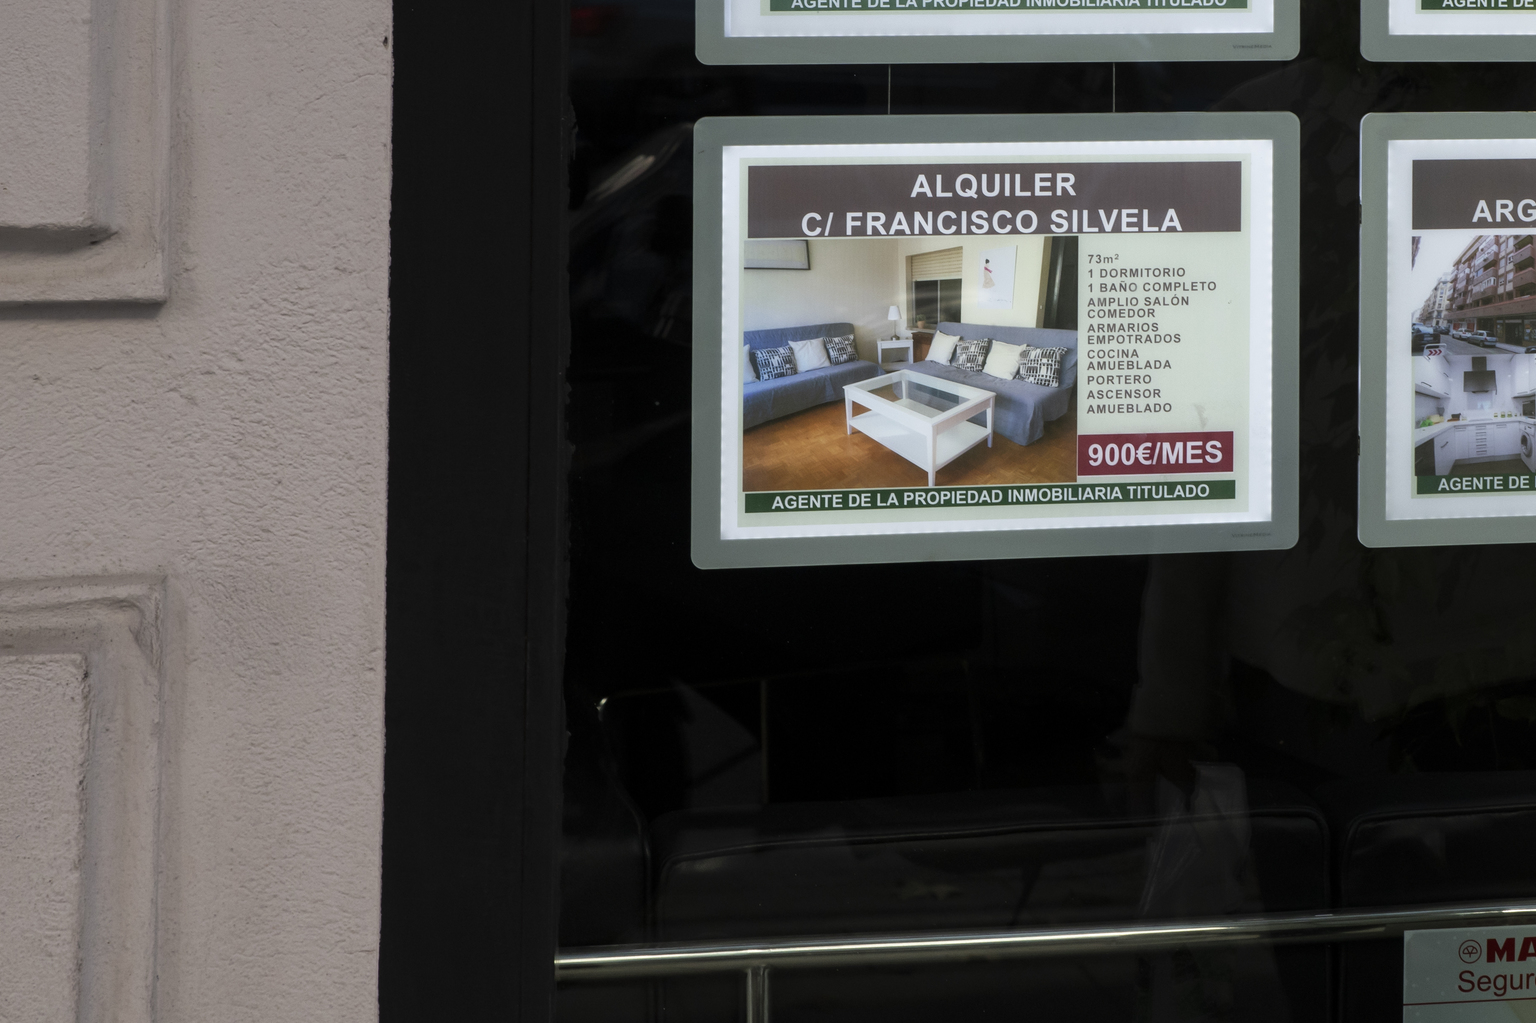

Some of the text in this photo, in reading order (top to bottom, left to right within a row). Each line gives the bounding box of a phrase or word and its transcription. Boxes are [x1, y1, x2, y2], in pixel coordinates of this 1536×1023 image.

[910, 173, 1076, 199] ALQUILER
[802, 208, 1182, 236] C/ FRANCISCO SILVELA
[1087, 294, 1189, 307] AMPLIO SALÓN
[1087, 308, 1155, 319] COMEDOR
[1087, 322, 1159, 333] ARMARIOS
[1088, 334, 1181, 345] EMPOTRADOS
[1087, 349, 1139, 359] COCINA
[1087, 360, 1171, 371] AMUEBLADA
[1087, 374, 1152, 385] PORTERO
[1087, 389, 1161, 400] ASCENSOR
[1087, 403, 1172, 414] AMUEBLADO
[1088, 441, 1222, 466] 900€/MES
[1438, 476, 1504, 491] AGENTE
[1509, 475, 1530, 489] DE
[772, 484, 1210, 509] AGENTE DE LA PROPIEDAD INMOBILIARIA TITULADO
